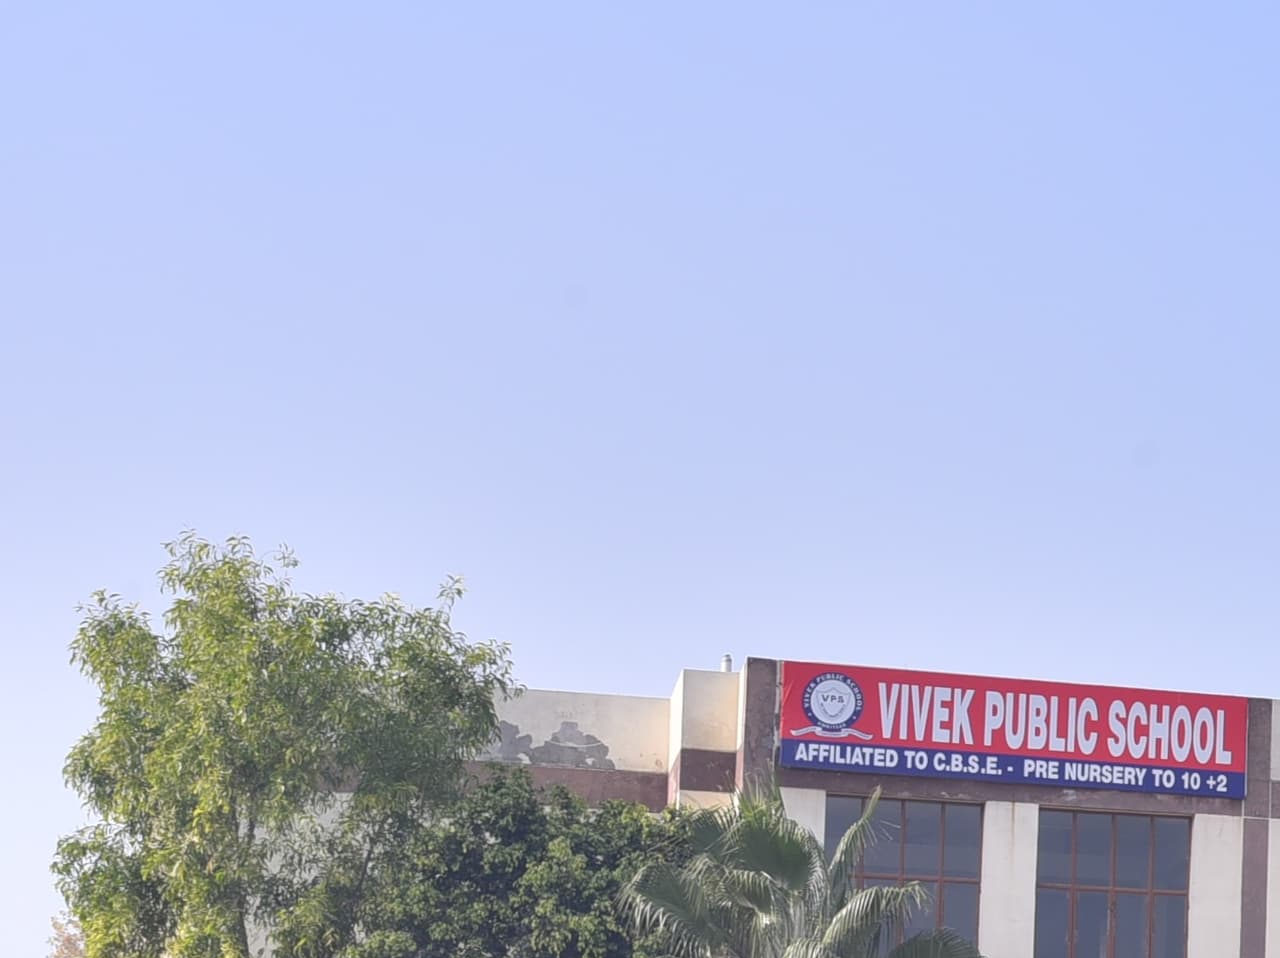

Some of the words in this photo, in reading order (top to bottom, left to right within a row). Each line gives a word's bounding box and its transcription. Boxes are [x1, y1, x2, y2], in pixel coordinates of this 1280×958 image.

[878, 682, 976, 745] VIVEK
[984, 690, 1099, 755] PUBLIC
[1107, 700, 1232, 765] SCHOOL
[795, 743, 899, 768] AFFILIATED
[904, 751, 929, 770] TO
[933, 753, 1002, 775] C.B.S.E.
[1023, 759, 1059, 779] PRE
[1064, 762, 1147, 786] NURSERY
[1152, 769, 1175, 788] TO
[1182, 772, 1201, 790] 10
[1206, 774, 1228, 792] +2
